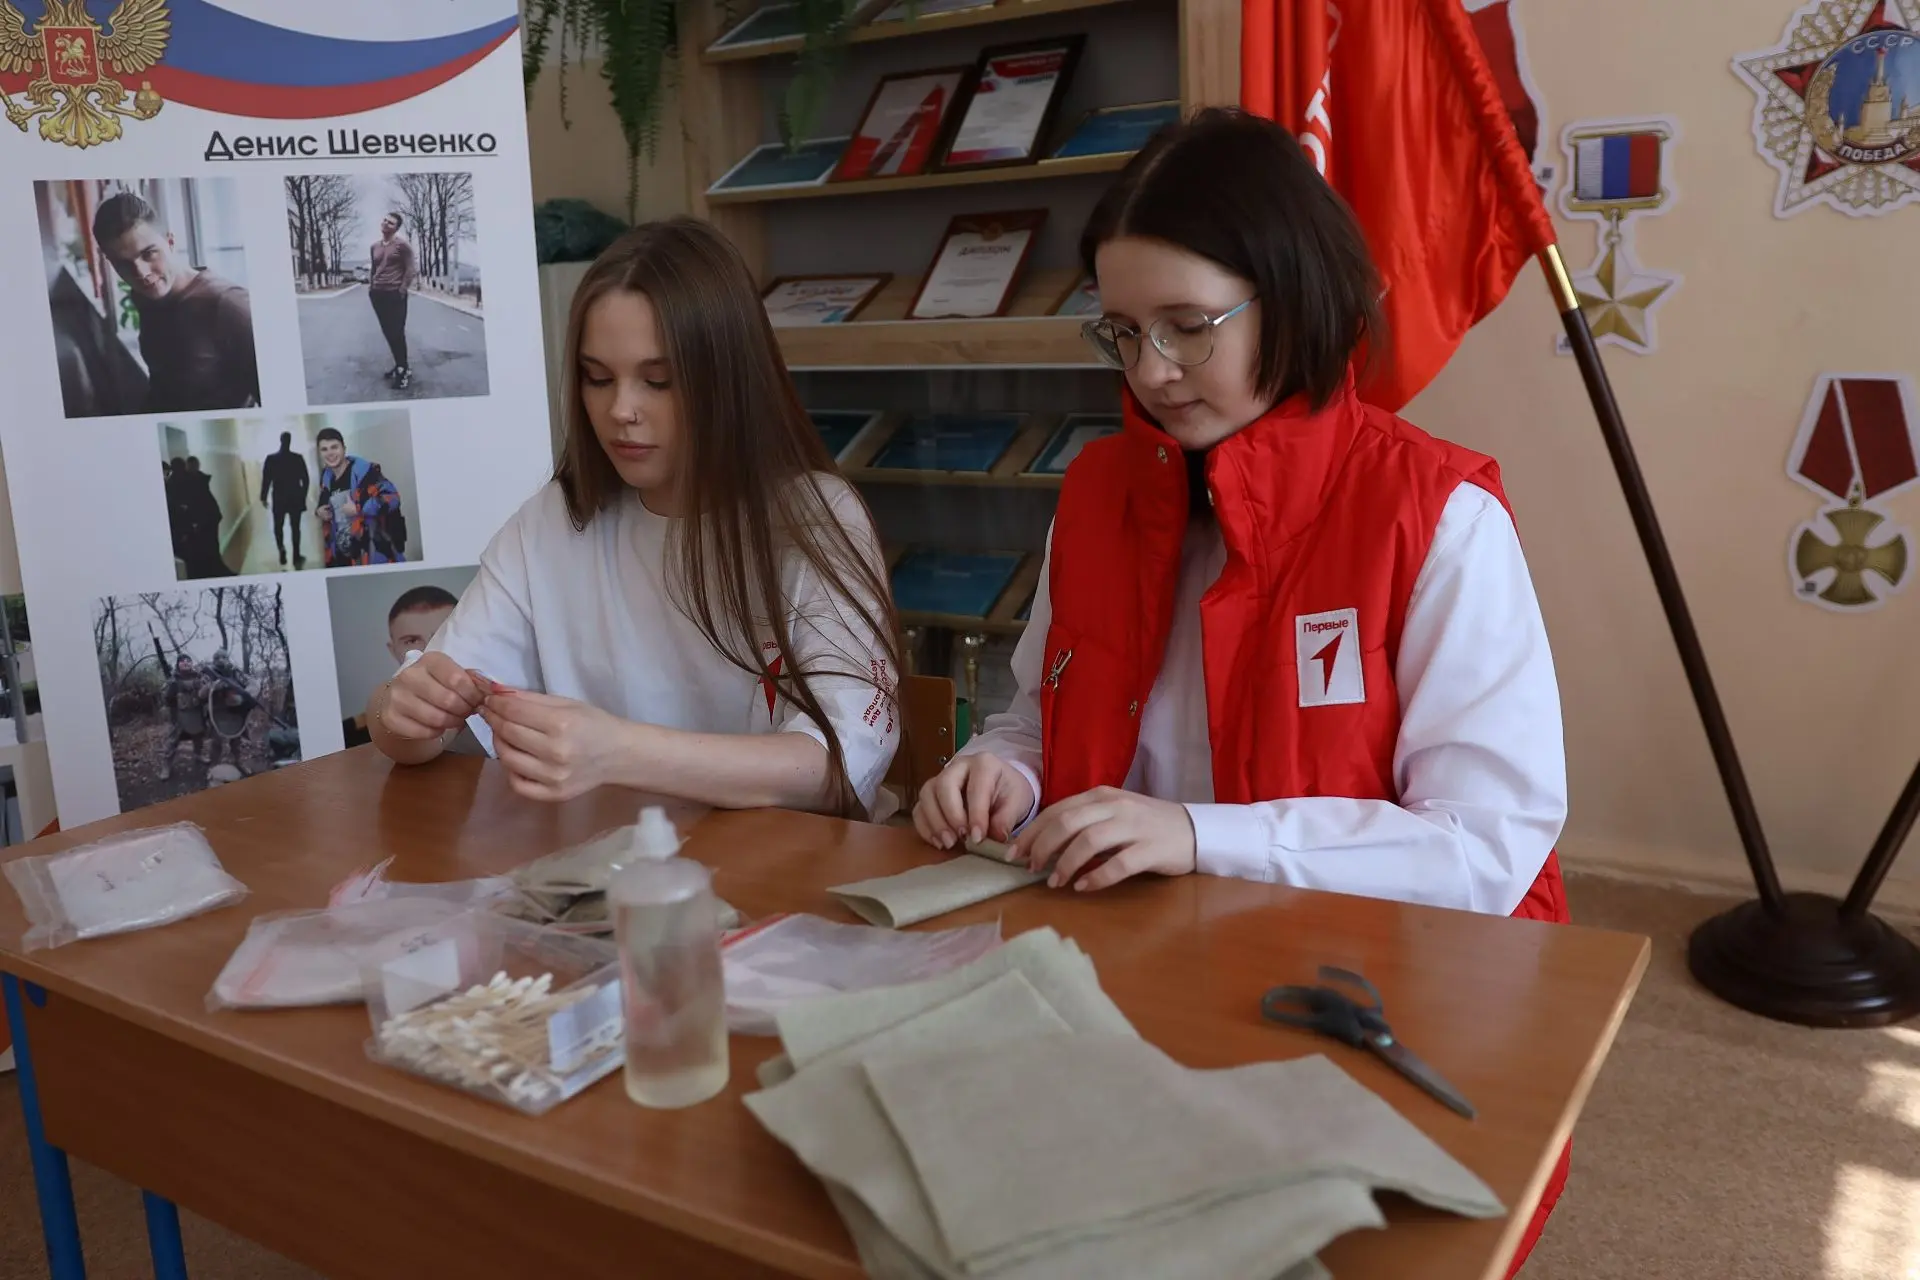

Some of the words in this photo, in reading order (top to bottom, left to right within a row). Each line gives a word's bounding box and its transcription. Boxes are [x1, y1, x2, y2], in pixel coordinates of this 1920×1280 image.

[1851, 34, 1914, 55] СССР
[204, 130, 319, 161] Денис
[327, 129, 498, 155] Шевченко
[1840, 142, 1907, 161] ПОБЕДА
[1303, 619, 1349, 634] Первые
